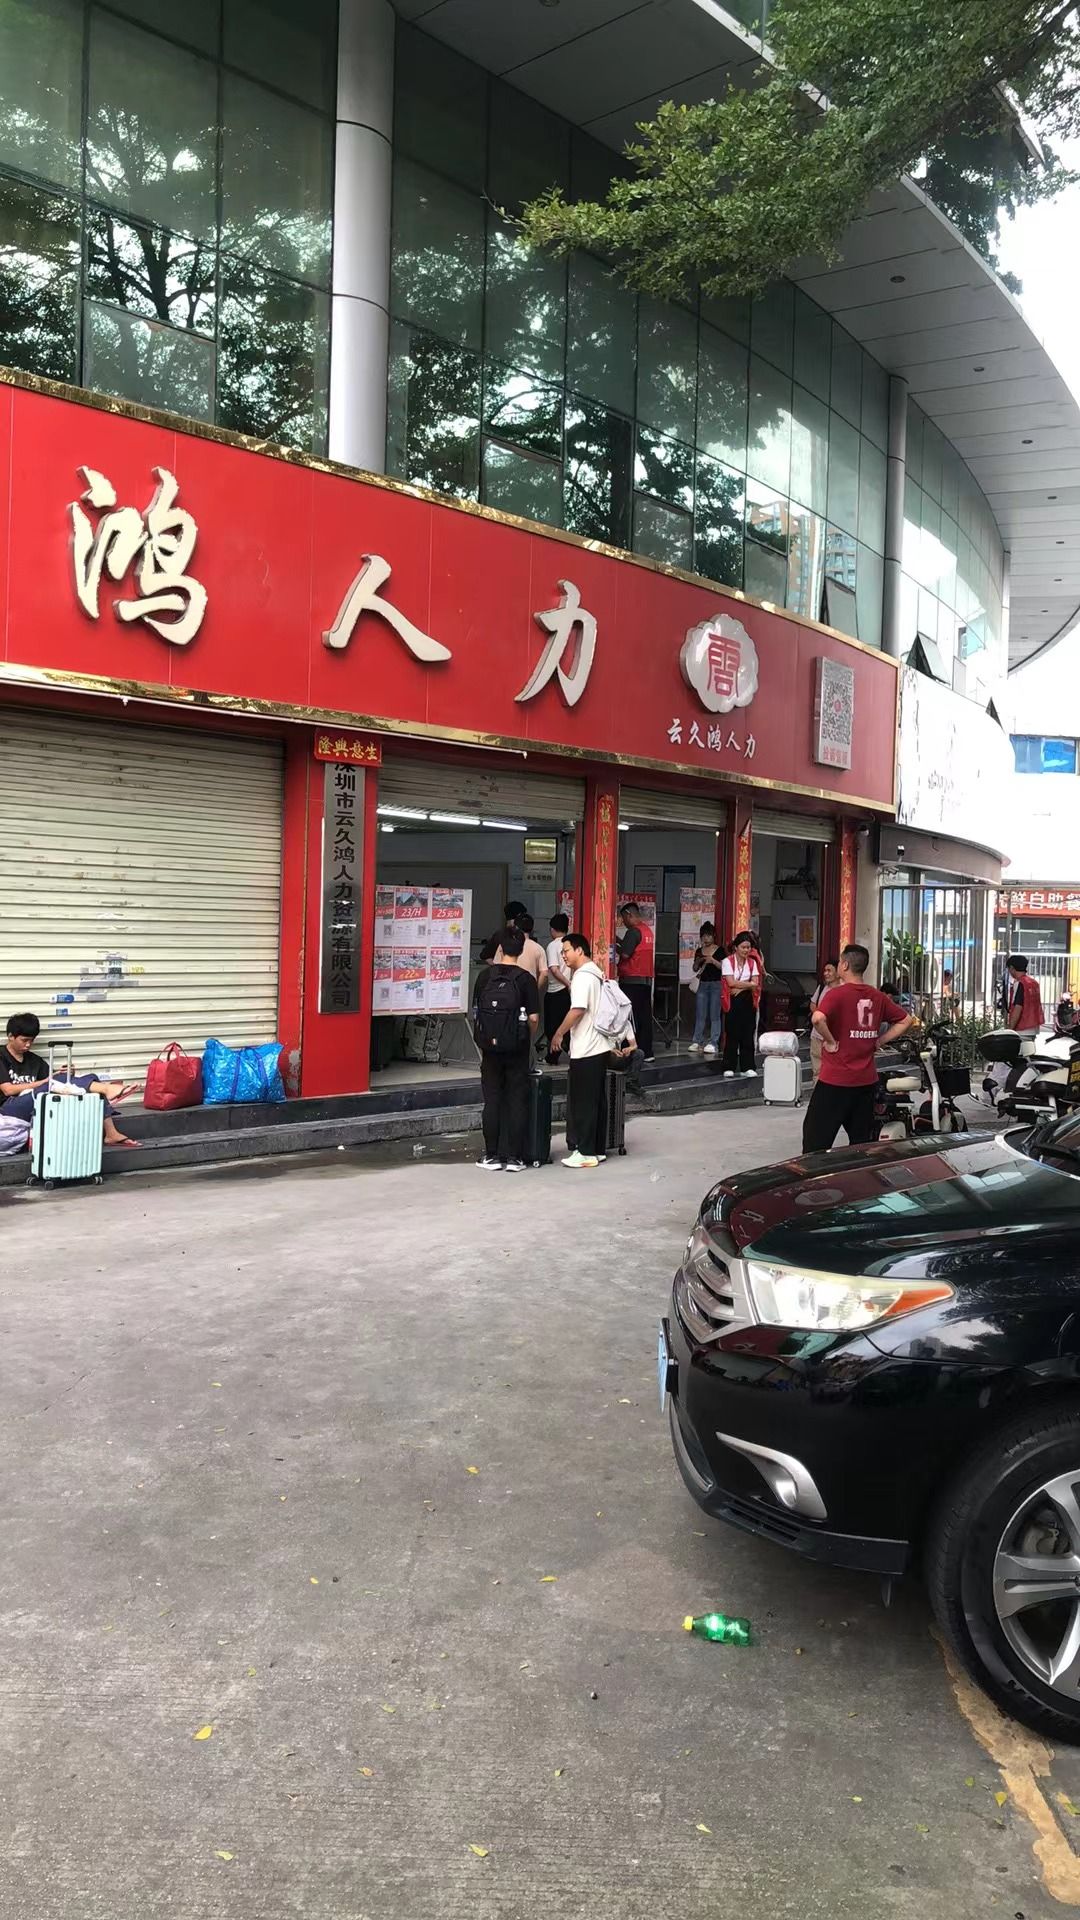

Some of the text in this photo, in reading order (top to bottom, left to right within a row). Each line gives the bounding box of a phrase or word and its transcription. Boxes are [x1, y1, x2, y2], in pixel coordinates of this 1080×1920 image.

[667, 718, 756, 759] 云久鸿人力
